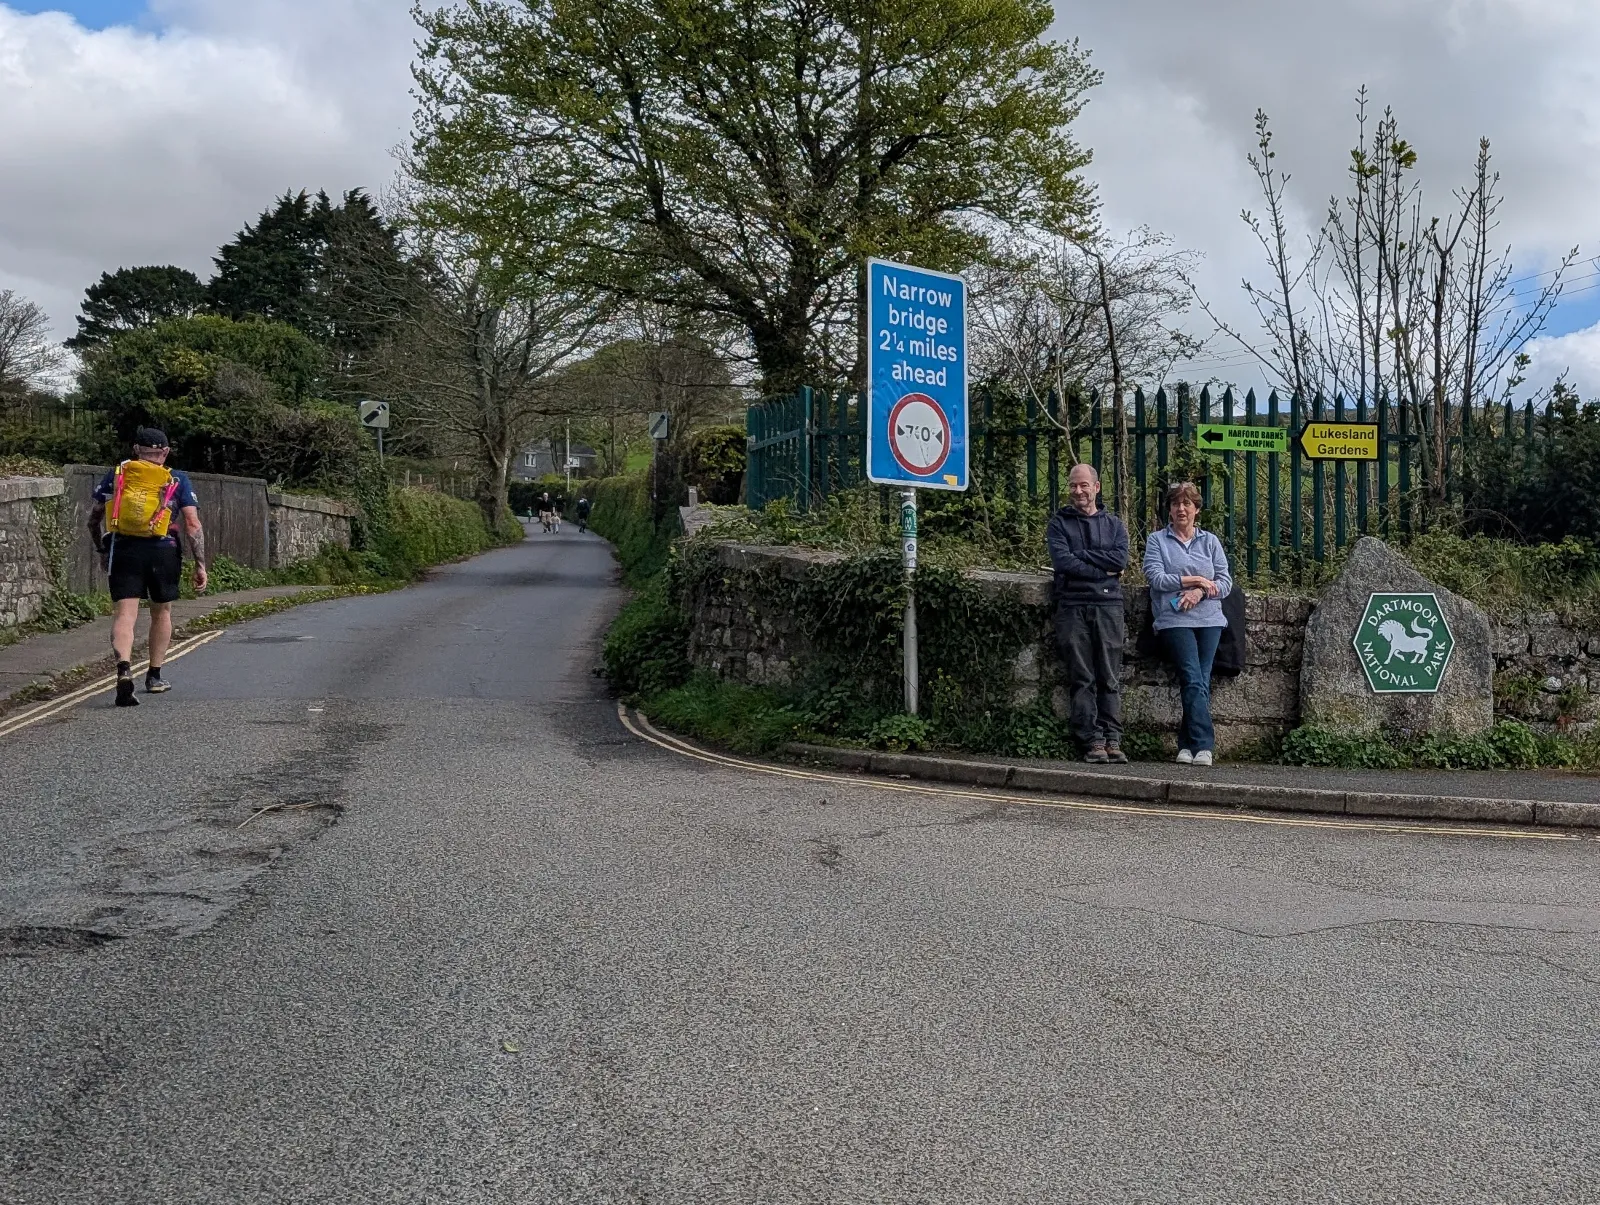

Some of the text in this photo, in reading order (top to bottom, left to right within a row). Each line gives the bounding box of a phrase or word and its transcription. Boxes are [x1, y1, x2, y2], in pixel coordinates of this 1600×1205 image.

[883, 275, 952, 307] Narrow
[889, 303, 947, 336] bridge
[910, 337, 957, 362] miles
[892, 360, 947, 387] ahead
[1228, 429, 1284, 440] HARFORD BARNS
[1243, 439, 1275, 448] CAMPING
[1312, 428, 1374, 439] Lukesland
[1318, 443, 1369, 456] Gardens
[1367, 599, 1438, 627] DARTMOOR
[1362, 641, 1418, 687] NATIONAL
[1424, 640, 1446, 676] PARK
